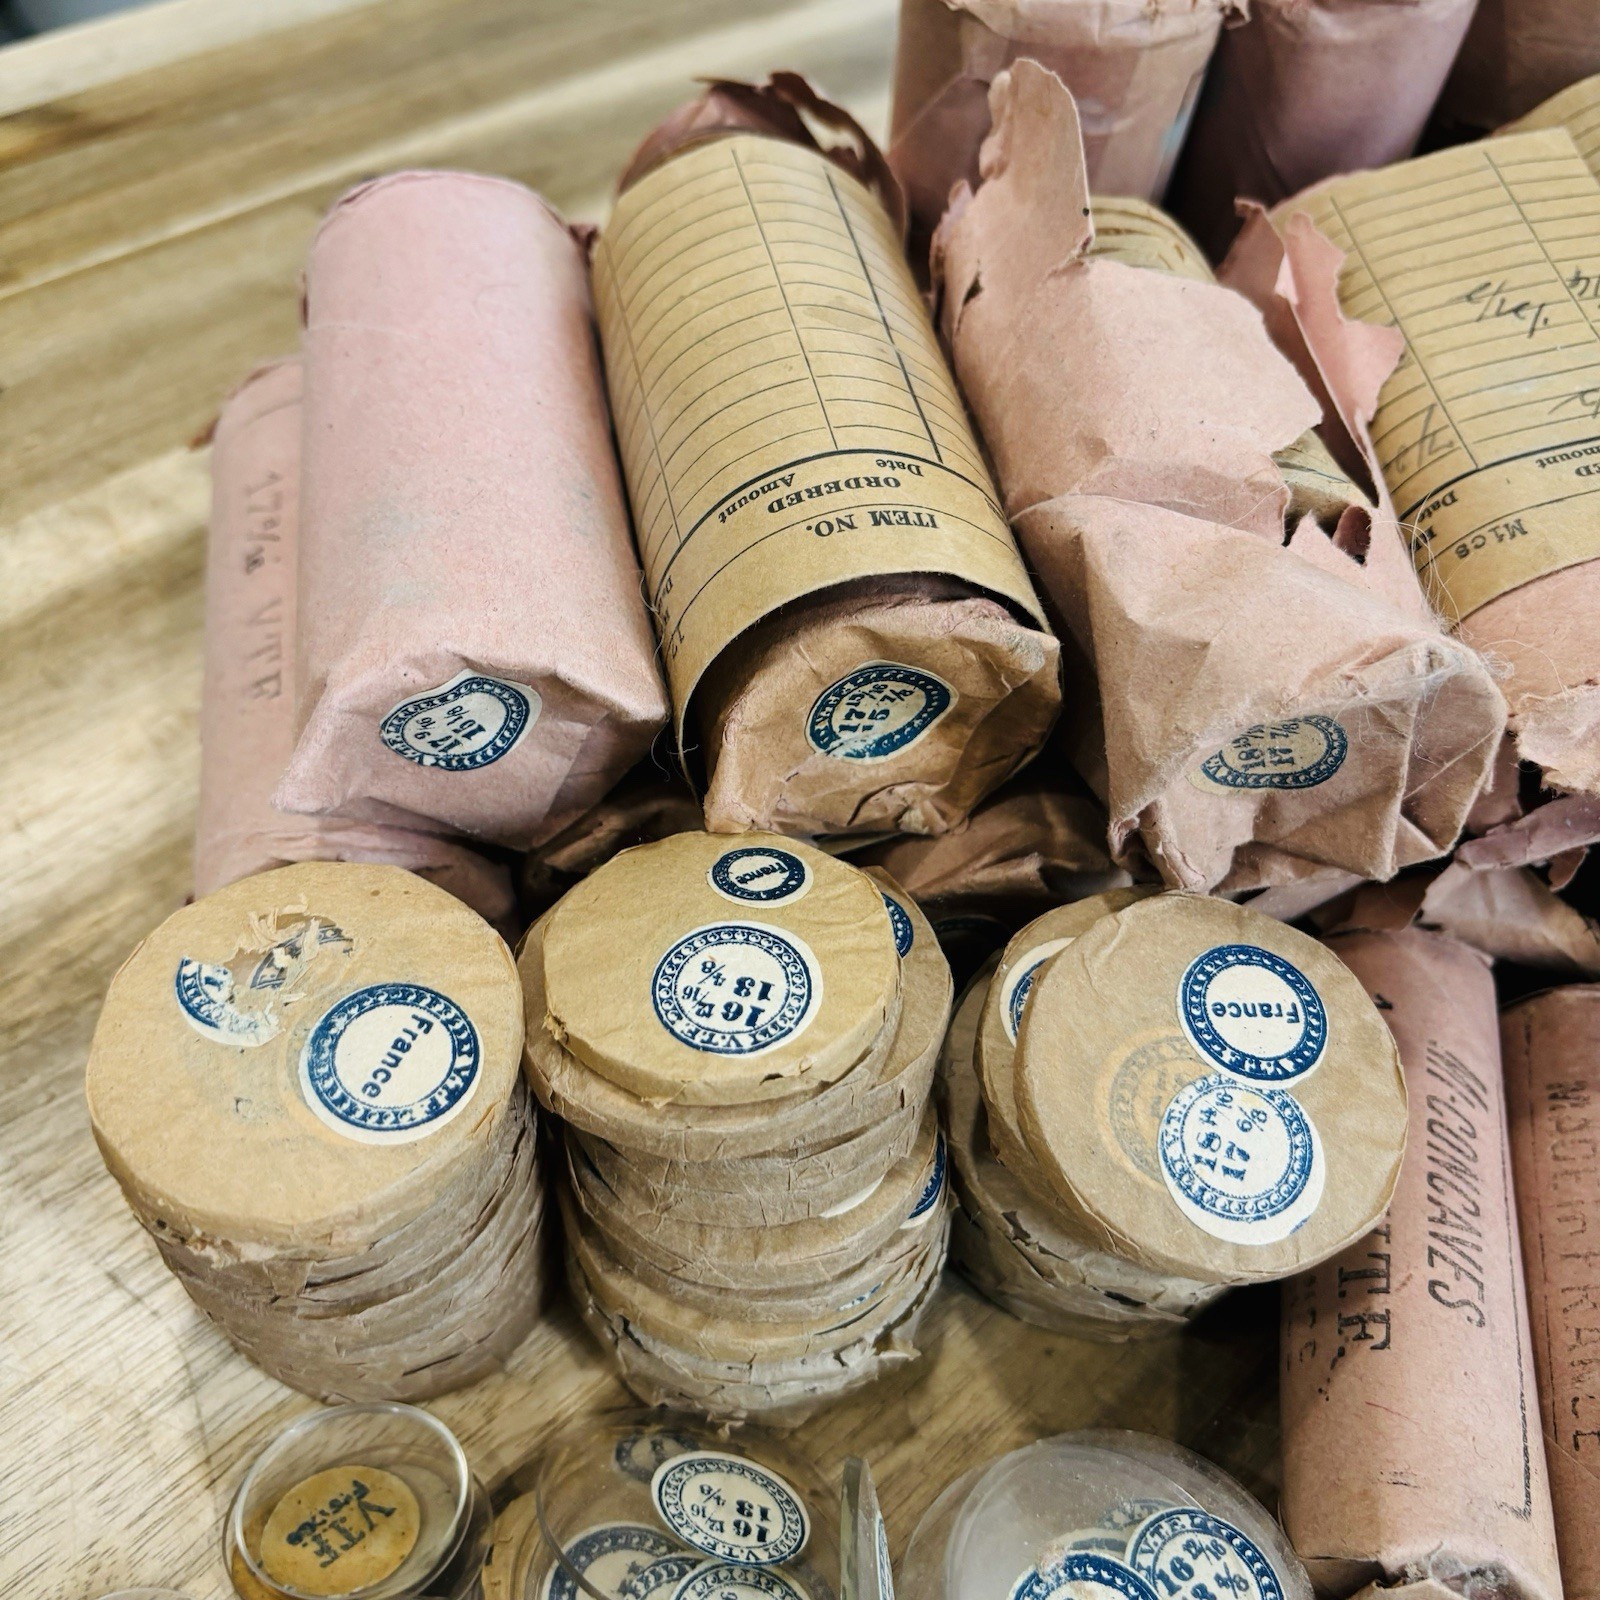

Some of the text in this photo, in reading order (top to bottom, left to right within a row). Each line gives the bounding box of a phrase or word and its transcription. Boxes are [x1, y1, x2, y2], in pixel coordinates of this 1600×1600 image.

[876, 457, 926, 478] Date
[1535, 446, 1600, 470] mount
[717, 472, 796, 525] Amount
[766, 475, 902, 515] ORDERED
[805, 509, 940, 538] ITEM NO.
[451, 719, 487, 742] 15
[839, 707, 867, 733] 17
[427, 734, 464, 753] 17
[735, 862, 789, 884] France
[697, 960, 776, 1002] 13 4/8
[682, 985, 766, 1028] 16 12/16
[1211, 1001, 1300, 1025] France
[680, 1021, 744, 1049] V.T.F.
[361, 1013, 434, 1099] France
[1192, 1131, 1223, 1173] 18
[1221, 1105, 1269, 1182] 17 6/8
[736, 1500, 771, 1522] 13
[733, 1519, 770, 1543] 16
[1155, 1556, 1195, 1597] 16
